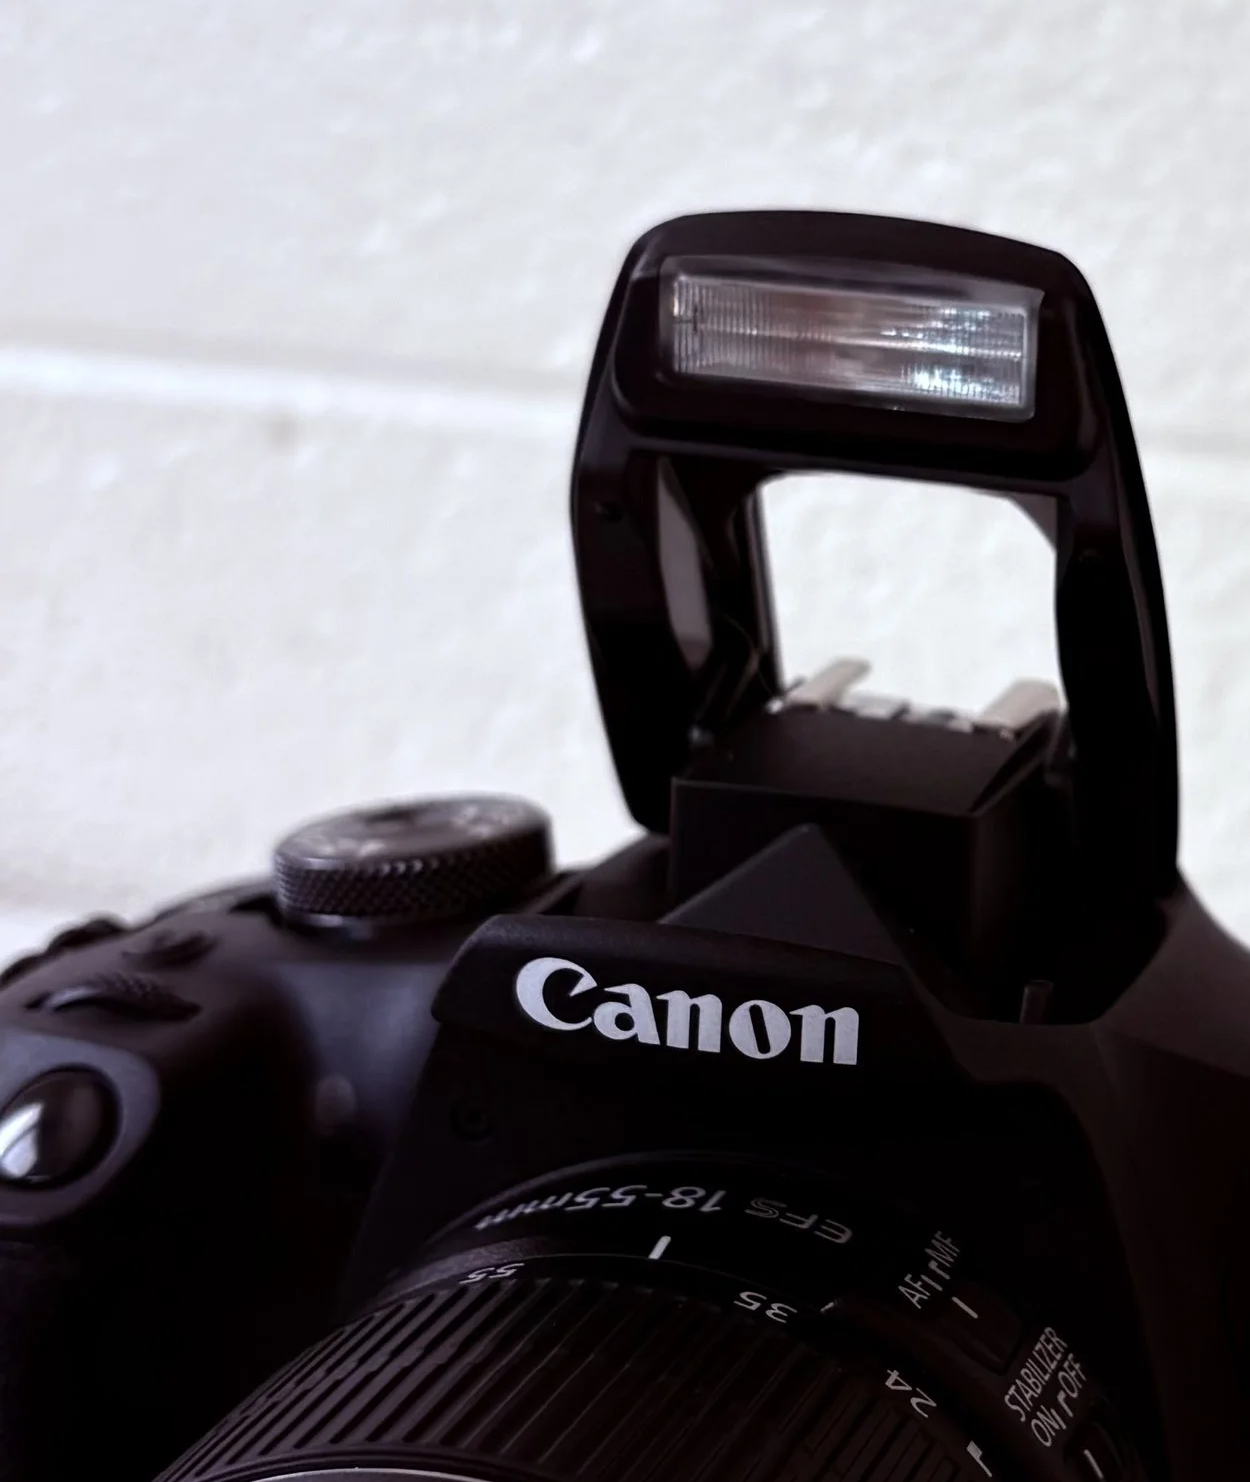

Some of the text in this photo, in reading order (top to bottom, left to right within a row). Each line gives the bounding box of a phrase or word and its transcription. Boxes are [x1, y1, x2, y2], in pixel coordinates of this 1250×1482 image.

[515, 956, 860, 1065] Canon
[474, 1184, 854, 1245] EFS 18-55mm
[458, 1262, 526, 1285] 55
[732, 1290, 799, 1324] 35
[885, 1369, 938, 1418] 24
[1004, 1326, 1069, 1422] STABILIZER
[1056, 1352, 1088, 1399] OFF
